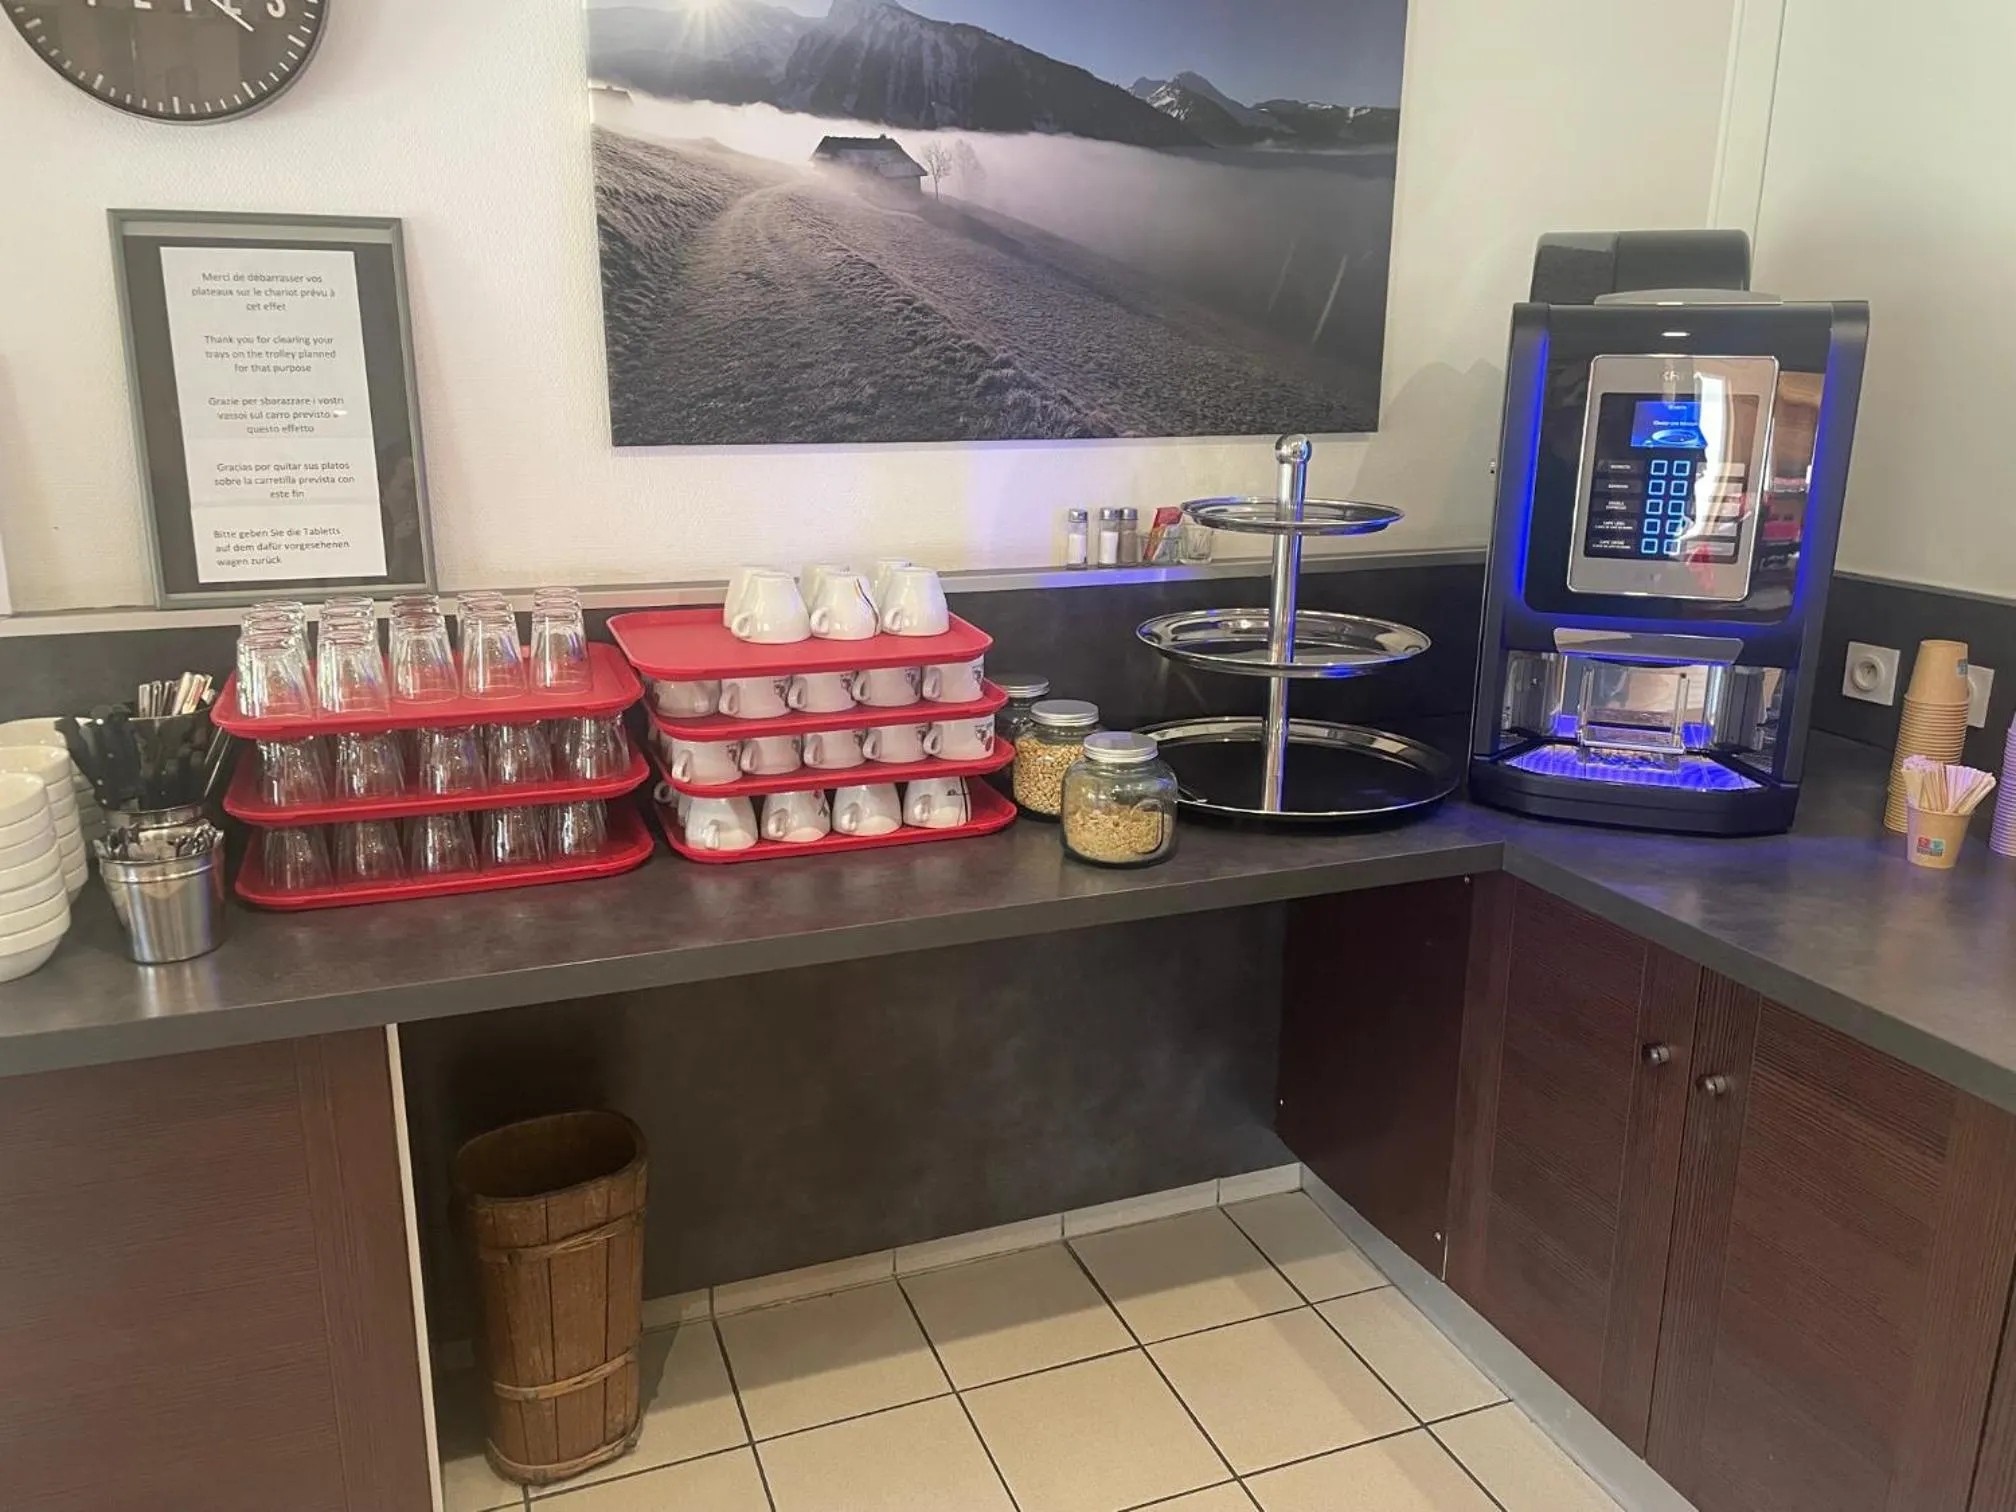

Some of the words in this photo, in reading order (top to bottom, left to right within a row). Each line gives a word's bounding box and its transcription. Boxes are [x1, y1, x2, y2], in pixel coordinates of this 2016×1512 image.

[202, 272, 231, 282] Merci
[233, 272, 246, 282] de
[306, 275, 323, 284] vos
[191, 287, 234, 297] plateaux
[236, 288, 250, 297] sur
[253, 287, 262, 296] le
[264, 287, 298, 297] chariot
[246, 303, 261, 311] cet
[263, 302, 286, 311] effet
[204, 335, 234, 344] Thank
[236, 337, 255, 346] you
[256, 335, 270, 344] for
[272, 335, 310, 346] clearing
[312, 337, 334, 346] your
[205, 350, 231, 360] trays
[247, 349, 263, 359] the
[265, 349, 296, 361] trolley
[298, 349, 336, 360] planned
[234, 363, 249, 372] for
[251, 363, 271, 372] that
[273, 364, 312, 374] purpose
[208, 397, 239, 406] Grazie
[242, 398, 257, 407] per
[318, 397, 345, 405] vostri
[250, 410, 264, 420] sul
[265, 411, 291, 419] carro
[292, 410, 331, 420] previsto
[246, 425, 280, 435] questo
[281, 424, 314, 433] effetto
[216, 462, 253, 472] Gracias
[255, 463, 271, 473] por
[273, 461, 301, 472] quitar
[321, 461, 350, 471] platos
[214, 476, 242, 486] sobre
[243, 476, 253, 485] la
[254, 475, 297, 485] carretilla
[299, 475, 336, 486] prevista
[337, 476, 355, 484] con
[269, 490, 290, 498] este
[291, 489, 305, 498] fin
[213, 529, 238, 539] Bitte
[239, 528, 269, 540] geben
[270, 528, 285, 537] Sie
[286, 527, 301, 537] die
[303, 527, 341, 537] Tabletts
[215, 543, 231, 552] auf
[233, 542, 255, 552] dem
[256, 541, 282, 551] dafür
[284, 541, 350, 552] vorgesehenen
[216, 557, 249, 568] wagen
[250, 556, 281, 565] zurück
